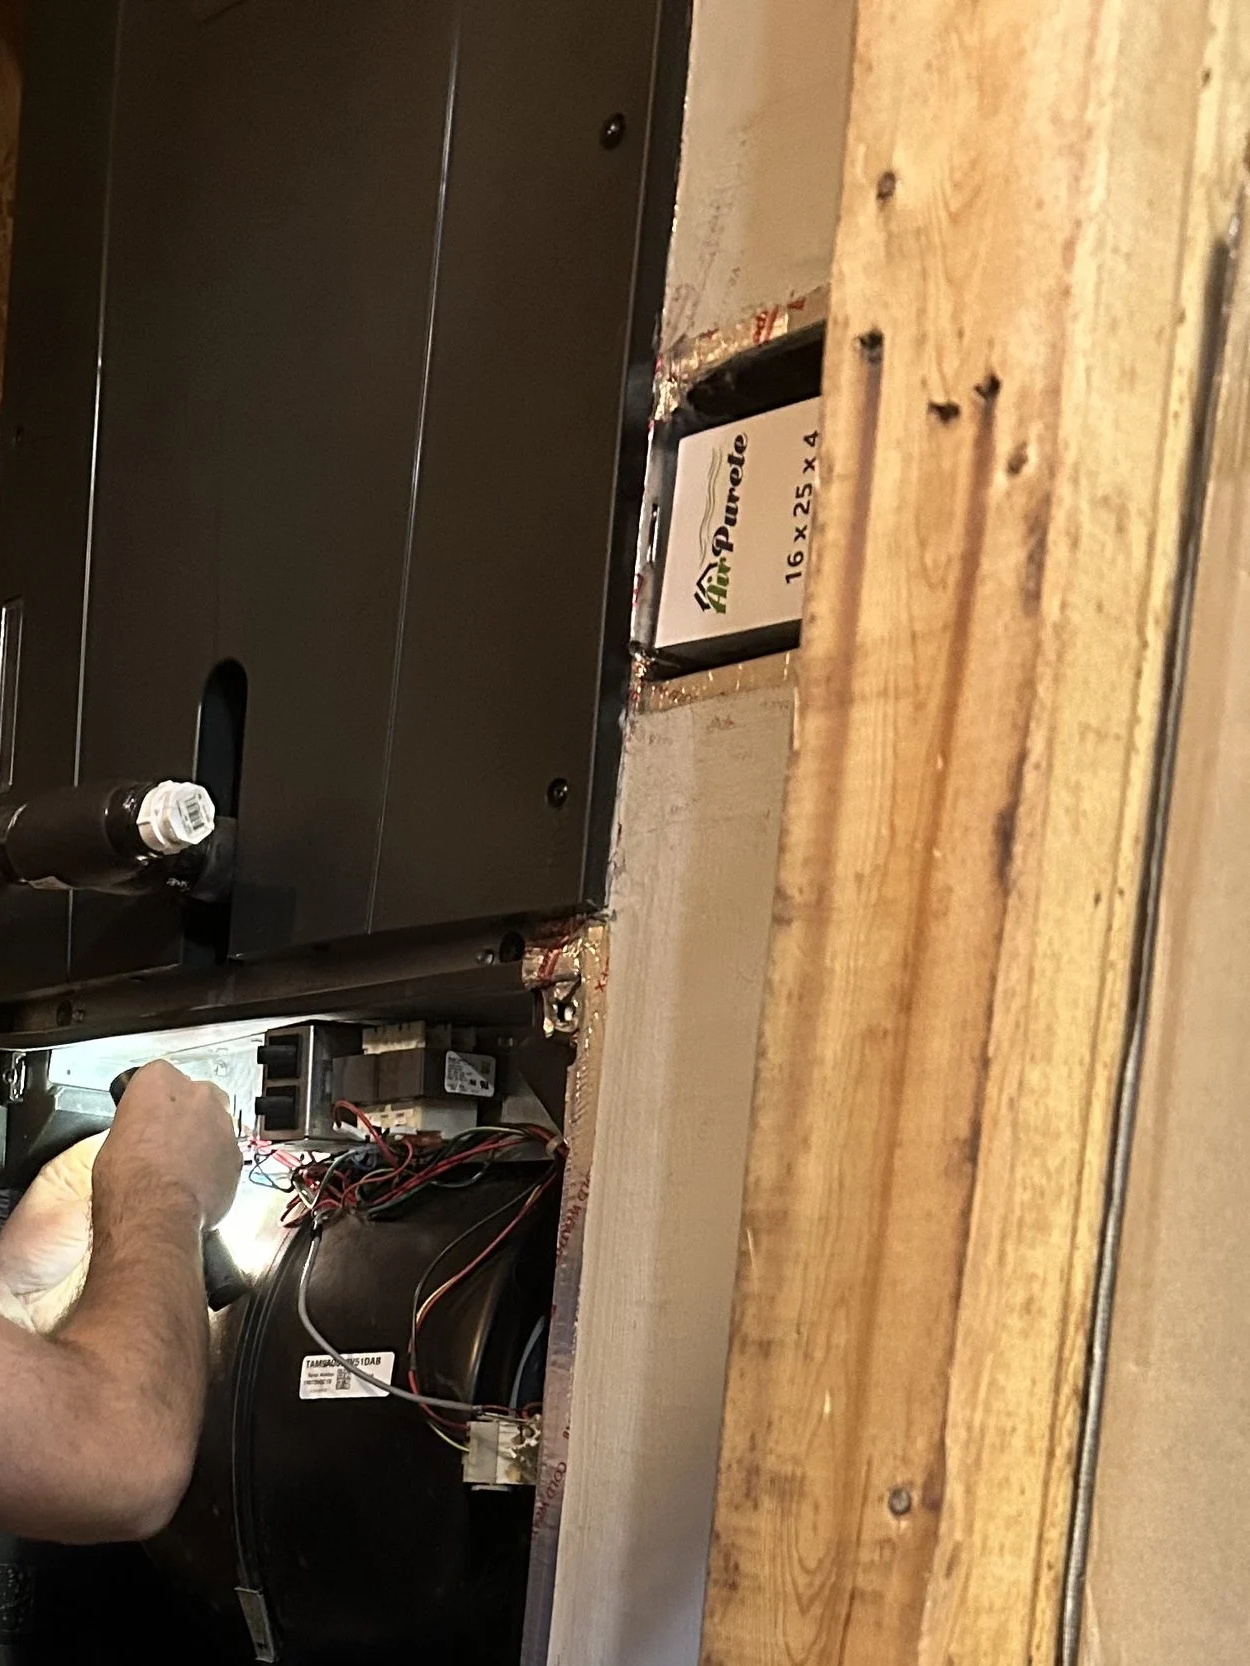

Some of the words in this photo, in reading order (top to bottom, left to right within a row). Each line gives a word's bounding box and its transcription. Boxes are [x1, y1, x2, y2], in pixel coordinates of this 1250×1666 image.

[803, 430, 819, 447] 4
[793, 483, 813, 516] 25
[784, 551, 804, 584] 16
[546, 1462, 566, 1499] COLD
